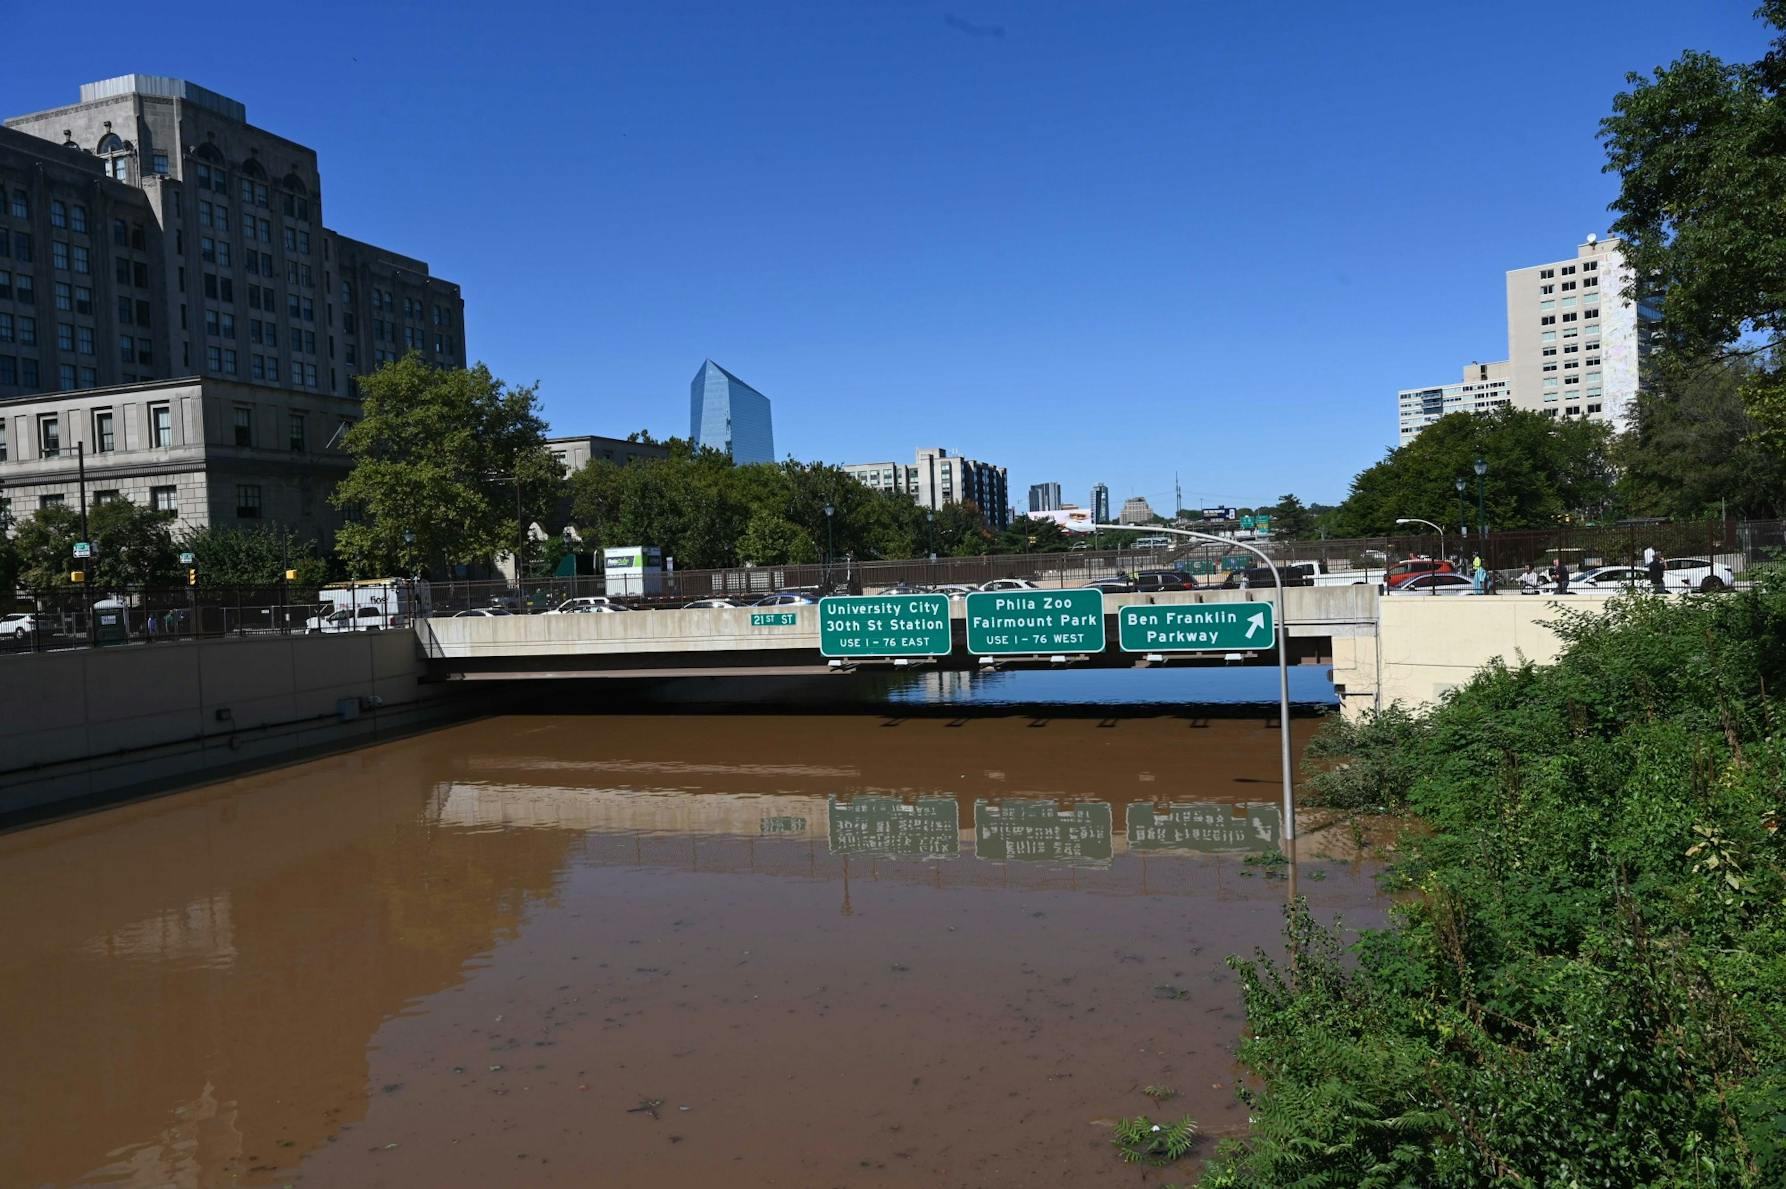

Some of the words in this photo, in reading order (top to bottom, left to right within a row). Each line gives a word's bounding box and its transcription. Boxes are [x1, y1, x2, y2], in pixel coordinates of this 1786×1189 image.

[827, 602, 901, 616] University
[909, 601, 940, 616] City
[995, 598, 1036, 610] Phila
[1043, 597, 1073, 609] Zoo
[781, 614, 793, 625] ST
[826, 620, 861, 632] 30th
[867, 619, 883, 631] St
[890, 618, 944, 631] Station
[973, 614, 1053, 629] Fairmount
[1060, 614, 1097, 627] Park
[1127, 613, 1158, 626] Ben
[1166, 611, 1237, 625] Franklin
[839, 638, 861, 648] USE
[901, 637, 930, 647] EAST
[986, 635, 1009, 645] USE
[1053, 633, 1085, 644] WEST
[1146, 630, 1219, 645] Parkway
